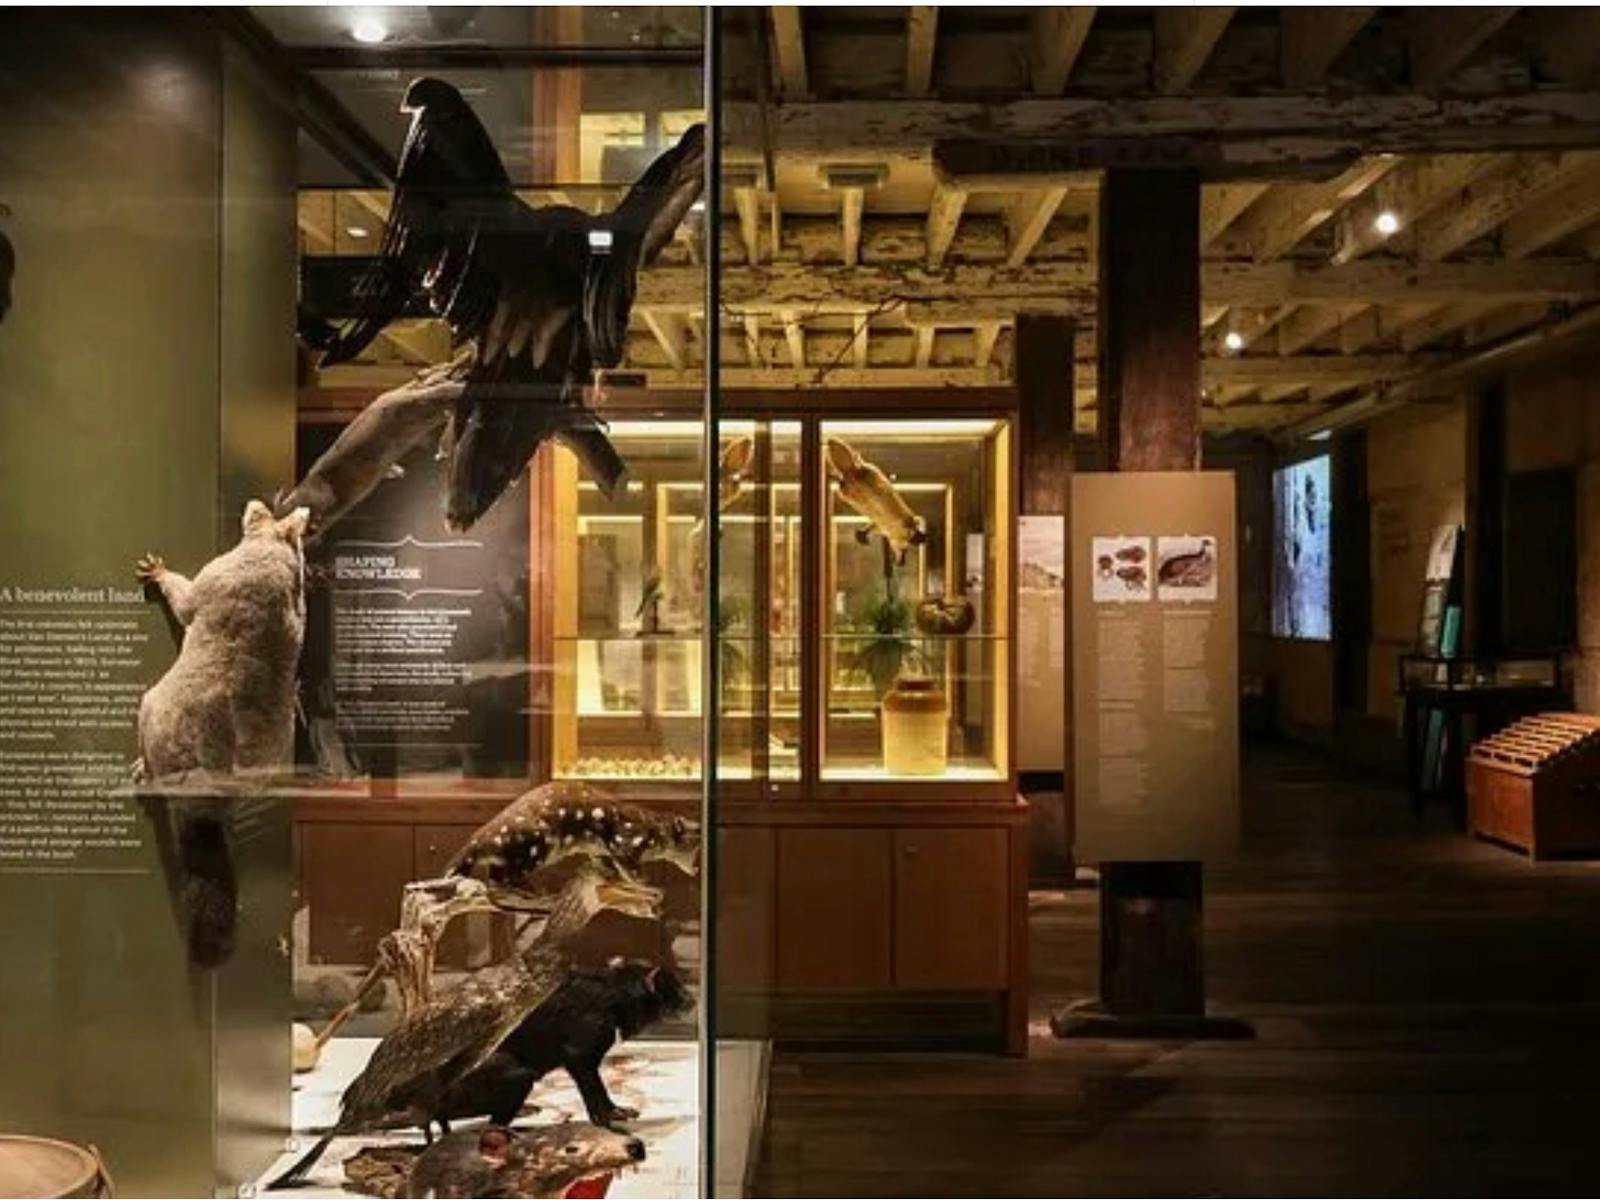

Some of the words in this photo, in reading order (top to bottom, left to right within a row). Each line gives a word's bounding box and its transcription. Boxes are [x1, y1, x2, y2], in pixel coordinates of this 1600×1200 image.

[0, 586, 13, 603] A
[15, 585, 105, 603] benevolent
[108, 585, 145, 603] land
